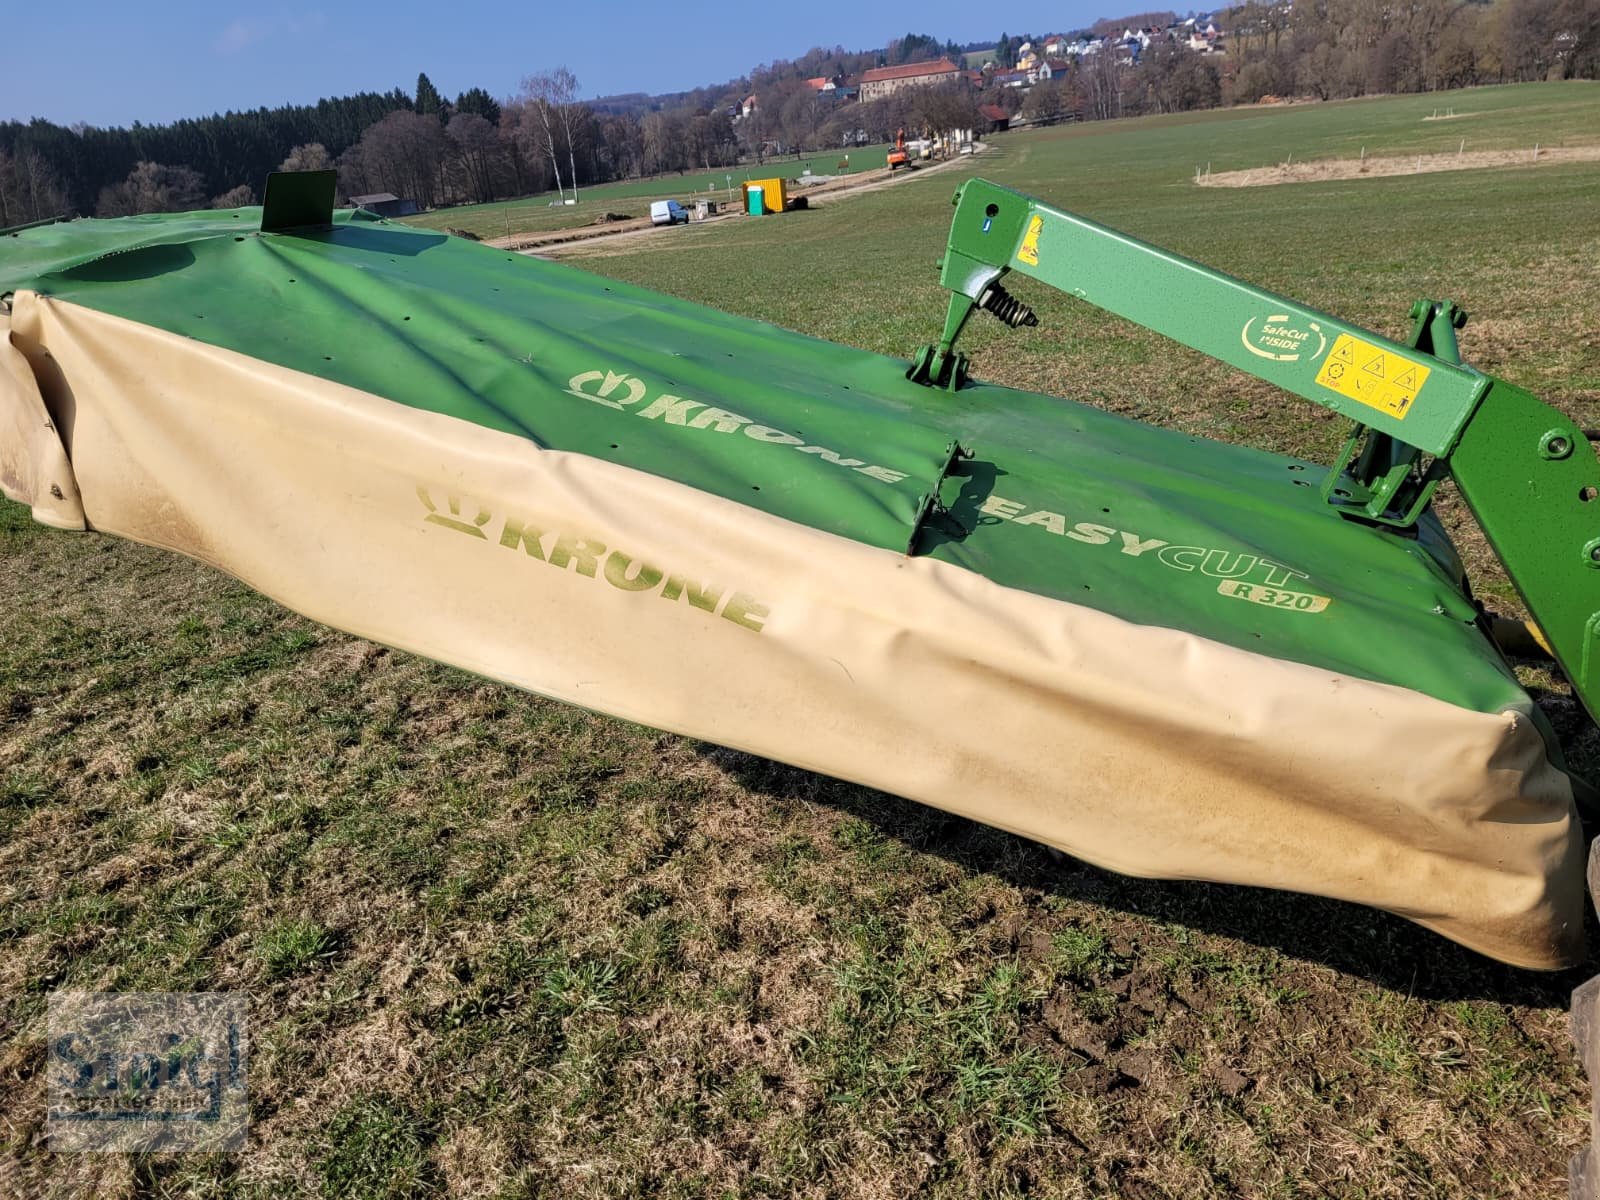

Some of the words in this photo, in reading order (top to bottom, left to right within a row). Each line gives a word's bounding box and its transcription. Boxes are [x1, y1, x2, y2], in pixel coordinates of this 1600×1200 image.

[1258, 335, 1300, 350] INSIDE
[1261, 324, 1309, 340] SafeCut
[635, 394, 912, 484] KRONE
[499, 516, 771, 633] KRONE
[1233, 584, 1253, 598] R
[1260, 590, 1313, 609] 320
